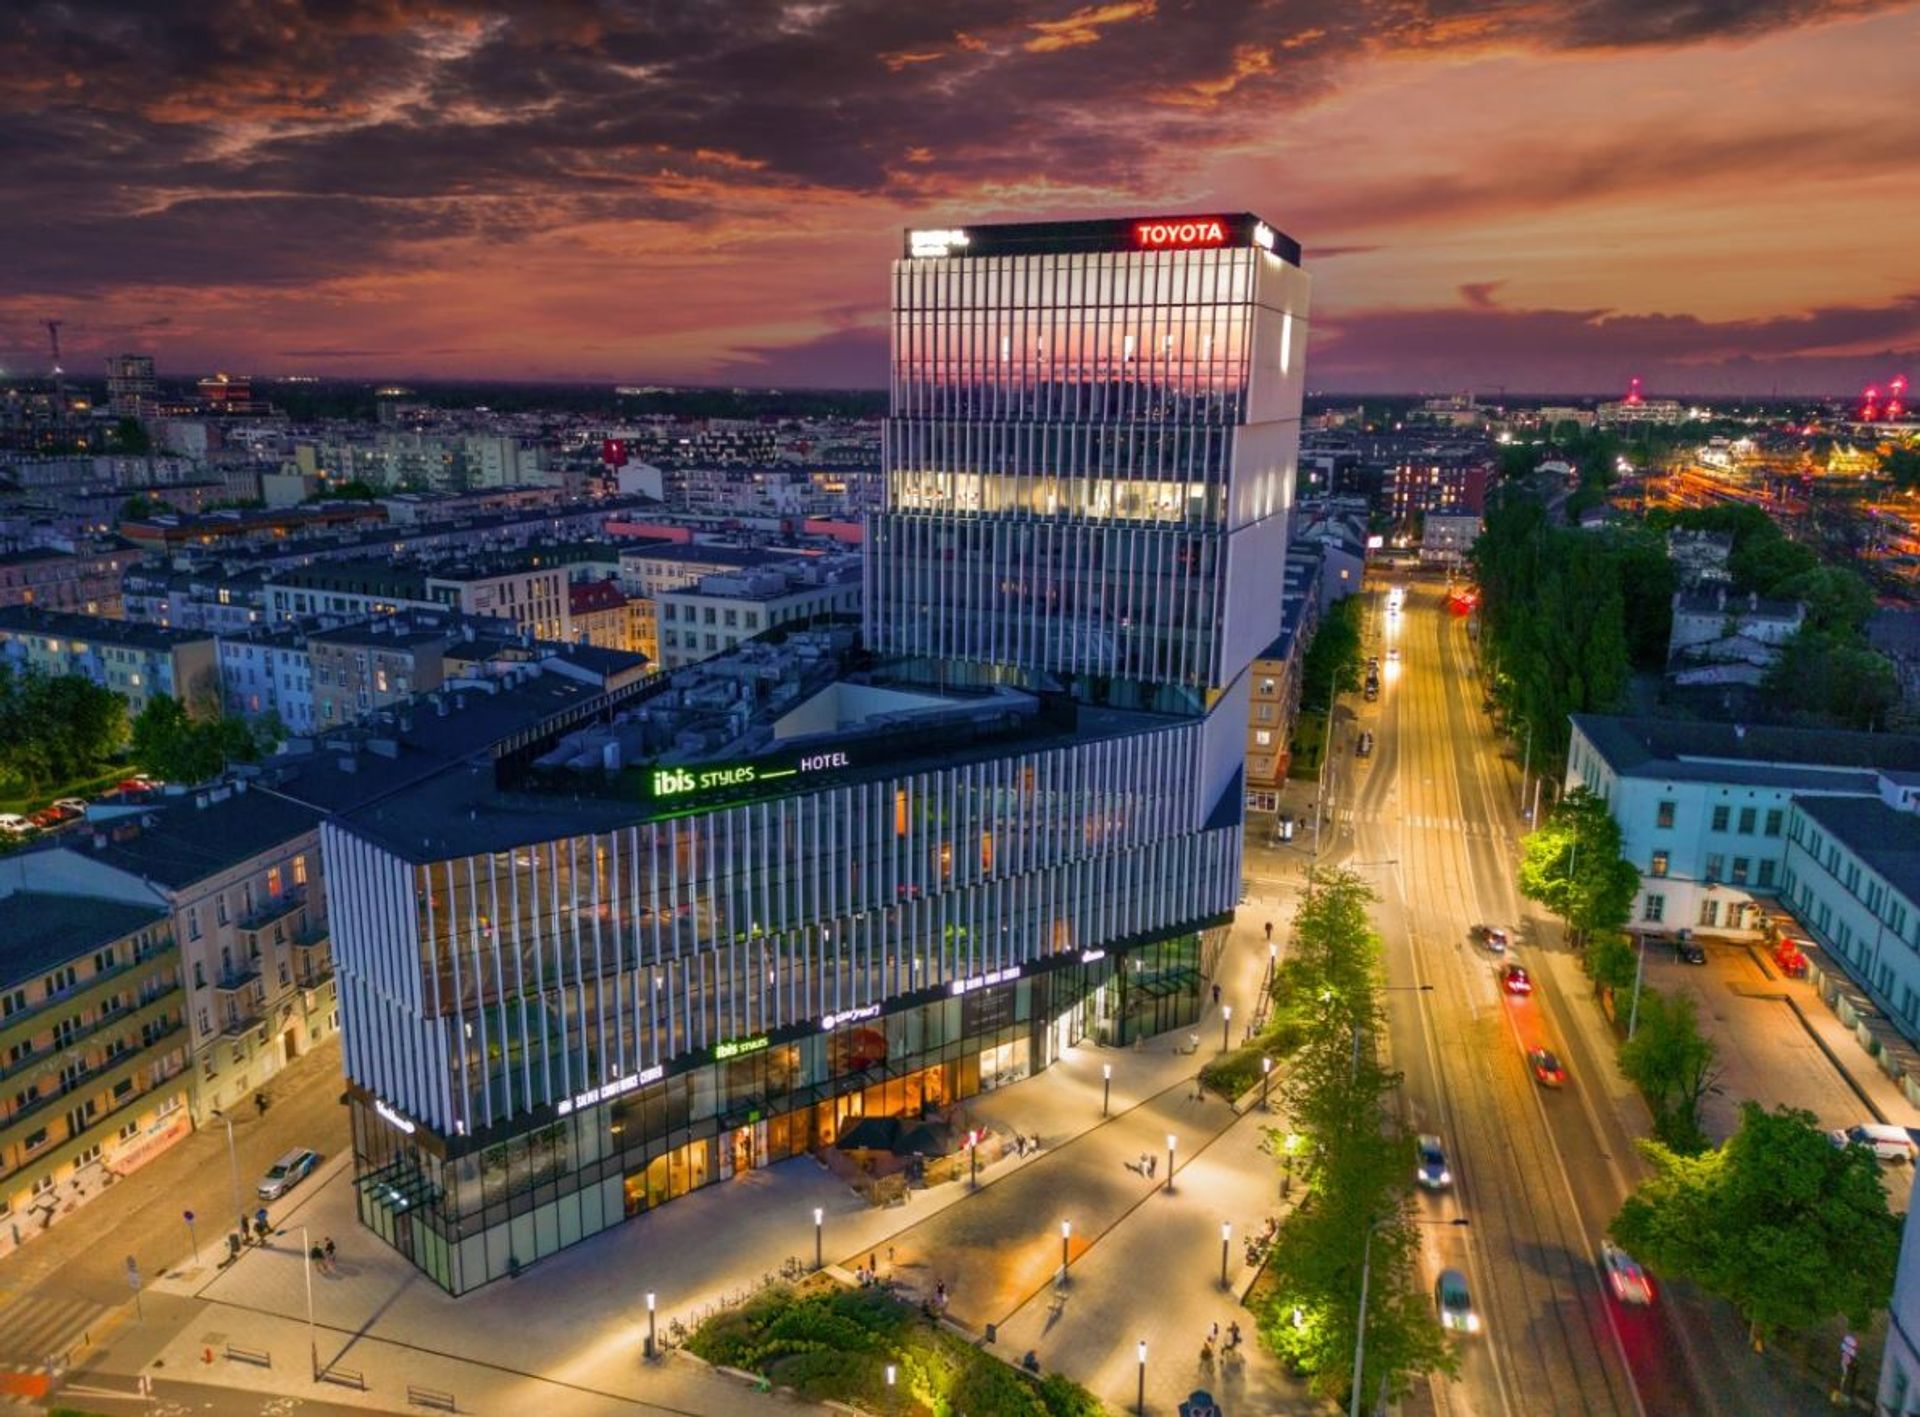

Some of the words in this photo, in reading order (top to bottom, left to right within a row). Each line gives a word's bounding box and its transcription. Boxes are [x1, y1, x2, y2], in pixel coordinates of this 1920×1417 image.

[1138, 222, 1224, 244] TOYOTA
[653, 768, 696, 796] ibis
[700, 766, 755, 789] STYLES
[801, 752, 849, 772] HOTEL
[716, 1043, 738, 1059] ibis
